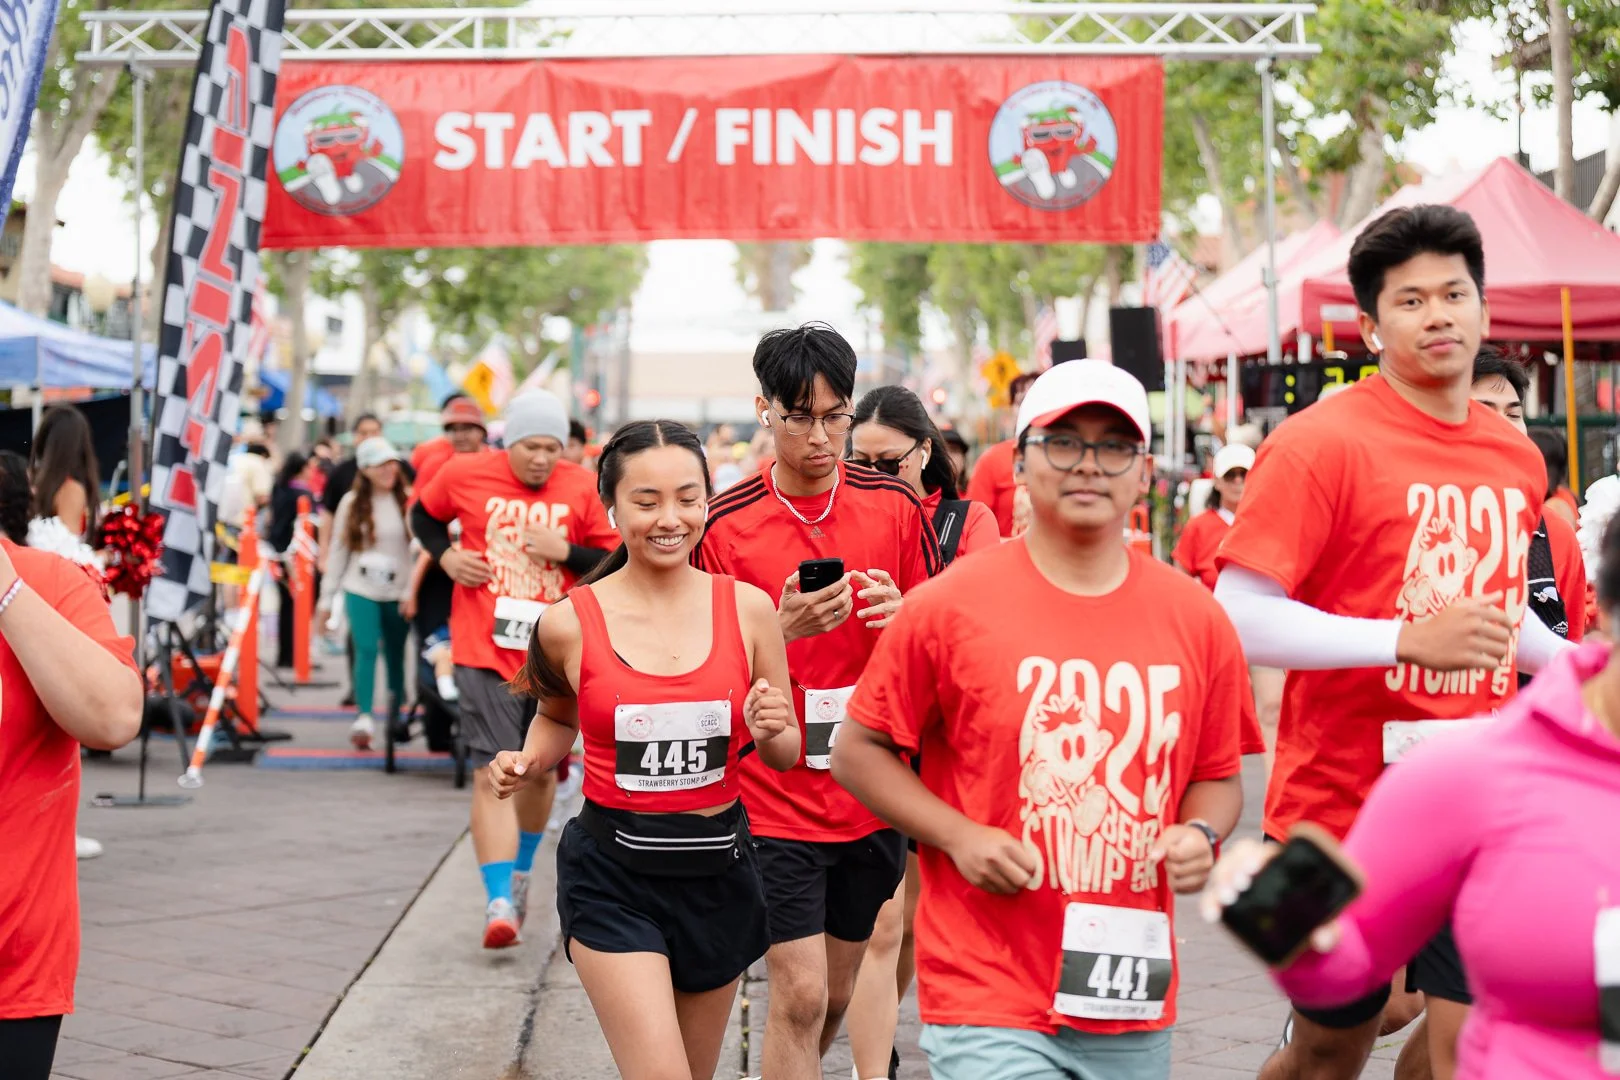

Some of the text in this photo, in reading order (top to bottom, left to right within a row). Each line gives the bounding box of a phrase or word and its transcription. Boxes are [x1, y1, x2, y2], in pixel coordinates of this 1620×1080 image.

[433, 107, 954, 171] START / FINISH
[640, 739, 707, 776] 445
[1016, 655, 1182, 817] 2025
[638, 779, 679, 788] STRAWBERRY
[679, 777, 700, 786] STOMP
[1087, 953, 1149, 1000] 441
